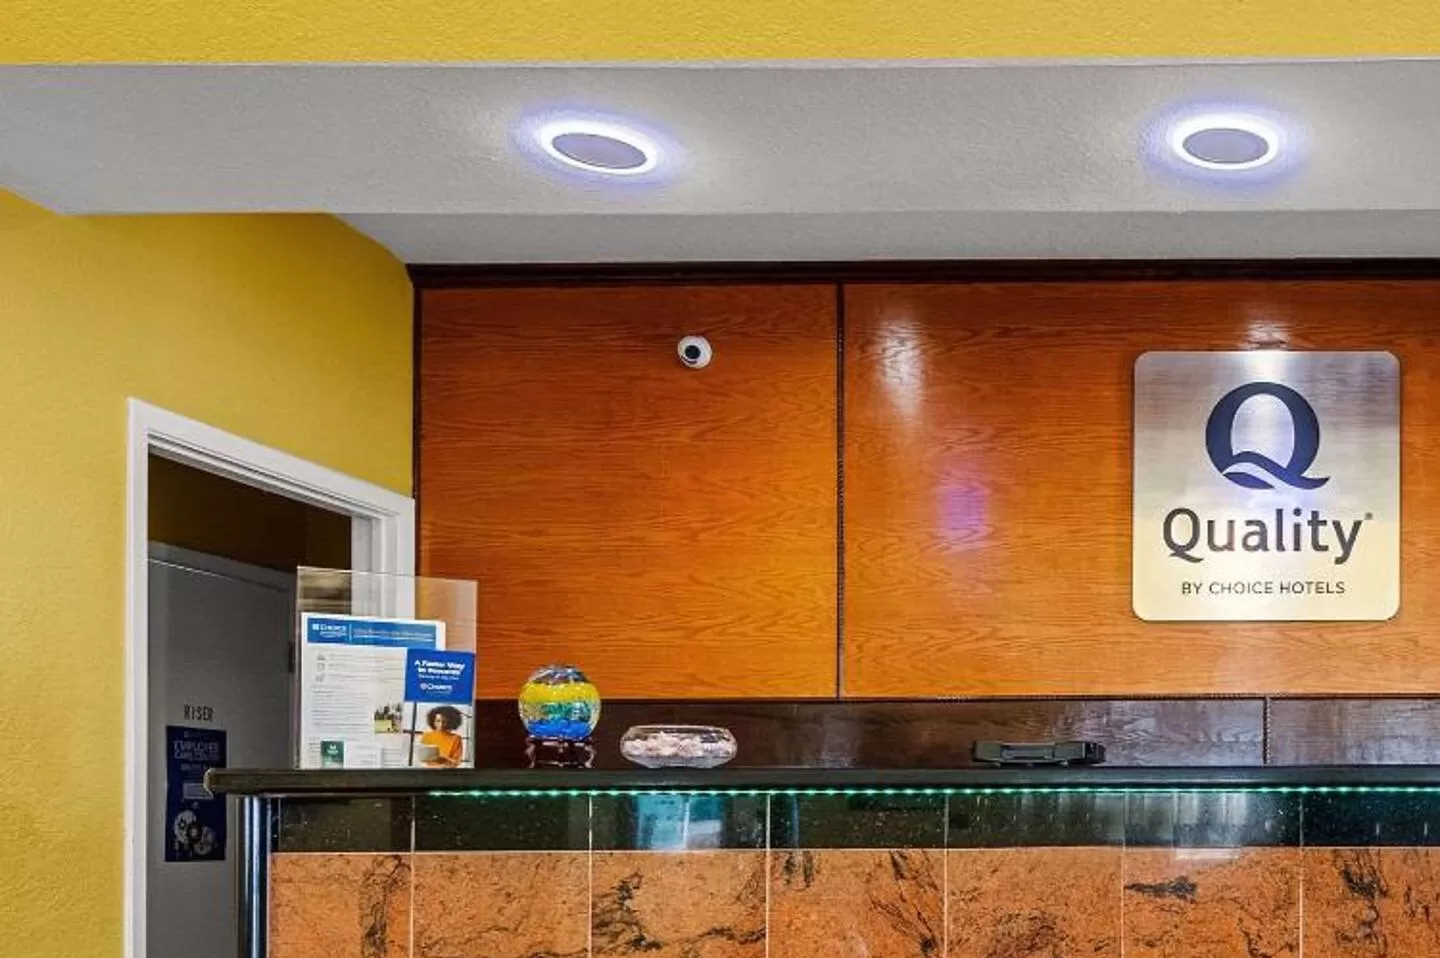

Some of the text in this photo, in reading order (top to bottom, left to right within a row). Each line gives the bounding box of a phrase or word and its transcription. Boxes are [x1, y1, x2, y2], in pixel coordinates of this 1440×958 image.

[1205, 381, 1331, 490] Q
[1163, 507, 1364, 565] Quality
[1181, 581, 1346, 595] BY CHOICE HOTELS
